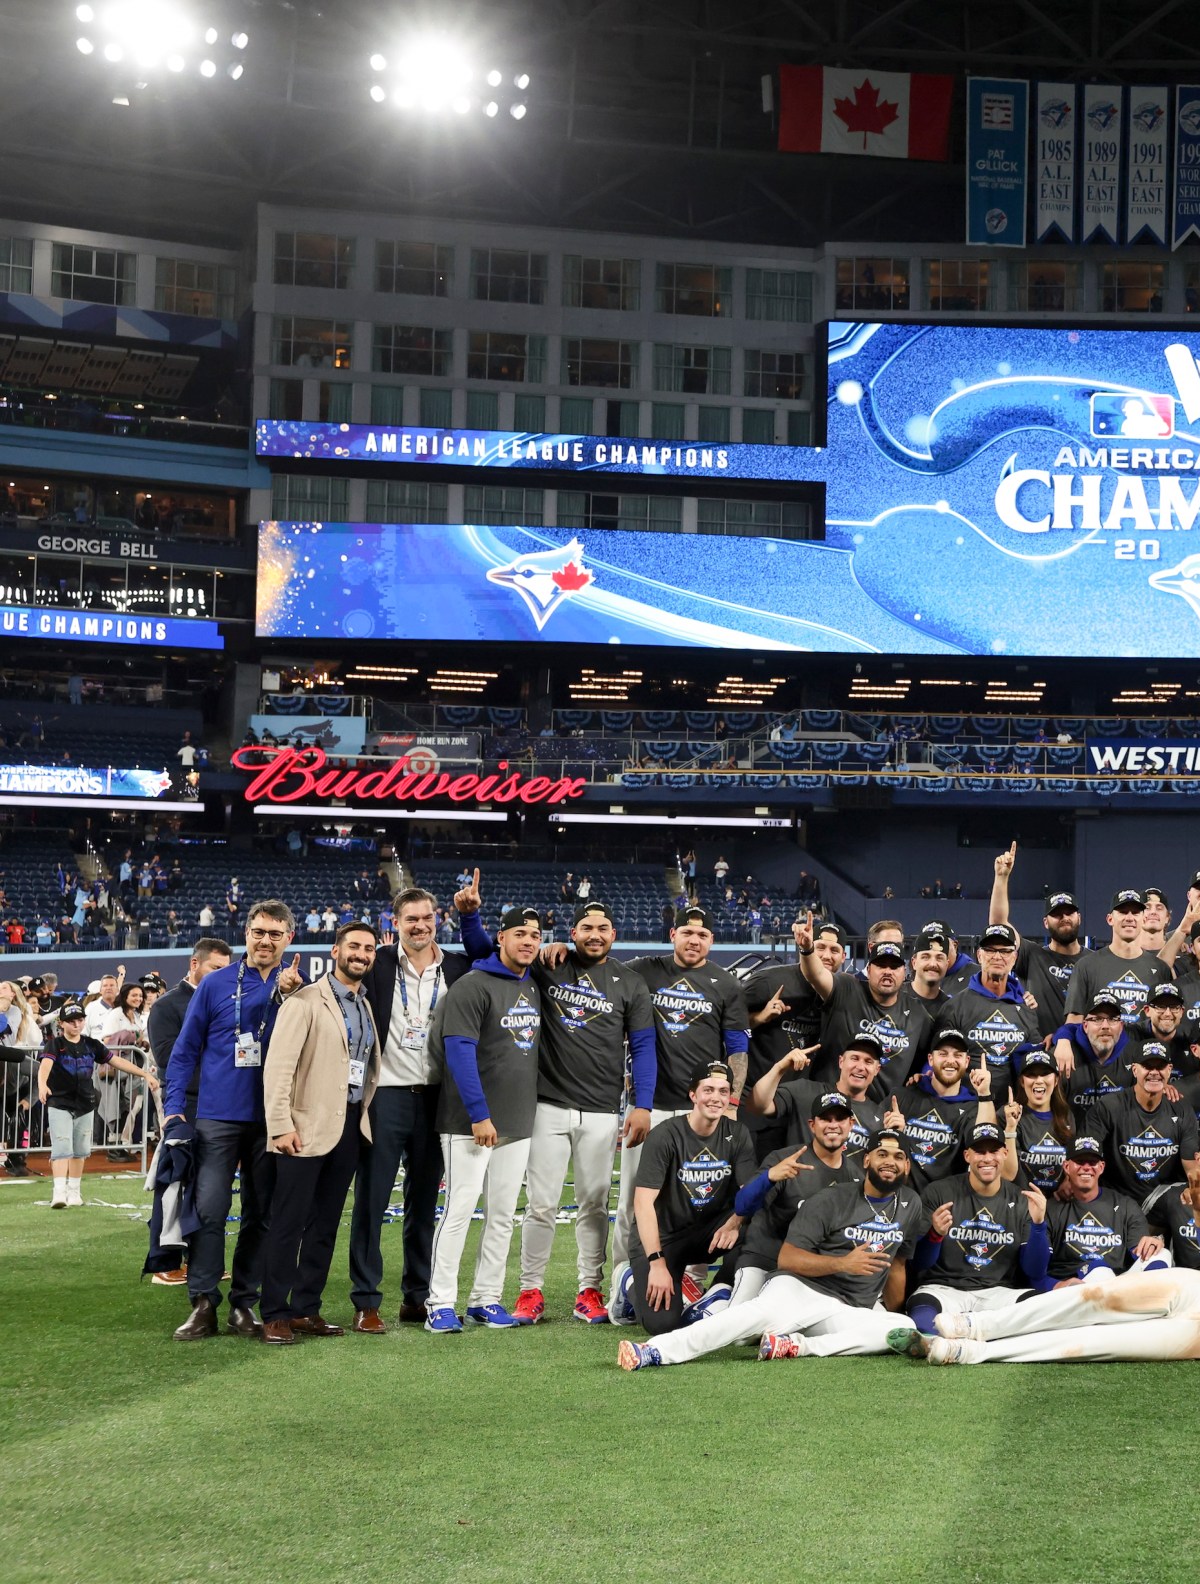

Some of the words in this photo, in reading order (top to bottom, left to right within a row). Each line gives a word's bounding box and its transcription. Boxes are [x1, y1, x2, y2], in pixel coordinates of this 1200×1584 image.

[988, 150, 1006, 161] PAT
[1040, 140, 1072, 161] 1985
[1087, 142, 1117, 162] 1989
[1133, 144, 1163, 164] 1991
[975, 160, 1018, 172] GILLICK
[1041, 165, 1071, 180] A.L.
[1087, 167, 1116, 182] A.L.
[1132, 169, 1163, 183] A.L.
[1041, 184, 1071, 200] EAST
[1087, 186, 1116, 201] EAST
[1132, 187, 1163, 203] EAST
[1040, 203, 1071, 212] CHAMPS
[1086, 206, 1115, 214] CHAMPS
[1131, 206, 1163, 215] CHAMPS
[365, 432, 486, 457] AMERICAN
[498, 439, 584, 463] LEAGUE
[595, 444, 729, 469] CHAMPIONS
[37, 535, 111, 555] GEORGE
[120, 543, 158, 559] BELL
[1114, 540, 1160, 561] 20
[40, 615, 167, 641] CHAMPIONS
[416, 737, 436, 746] HOME
[437, 737, 450, 745] RUN
[451, 737, 468, 745] ZONE
[230, 745, 586, 804] Budweiser
[548, 985, 614, 1013] CHAMPIONS
[968, 1030, 1025, 1042] CHAMPIONS
[1119, 1144, 1180, 1158] CHAMPIONS
[914, 1155, 931, 1163] 2025
[677, 1164, 732, 1182] CHAMPIOS
[949, 1227, 1014, 1245] CHAMPIONS
[1066, 1232, 1122, 1247] HAMPIONS
[969, 1256, 988, 1265] 2025
